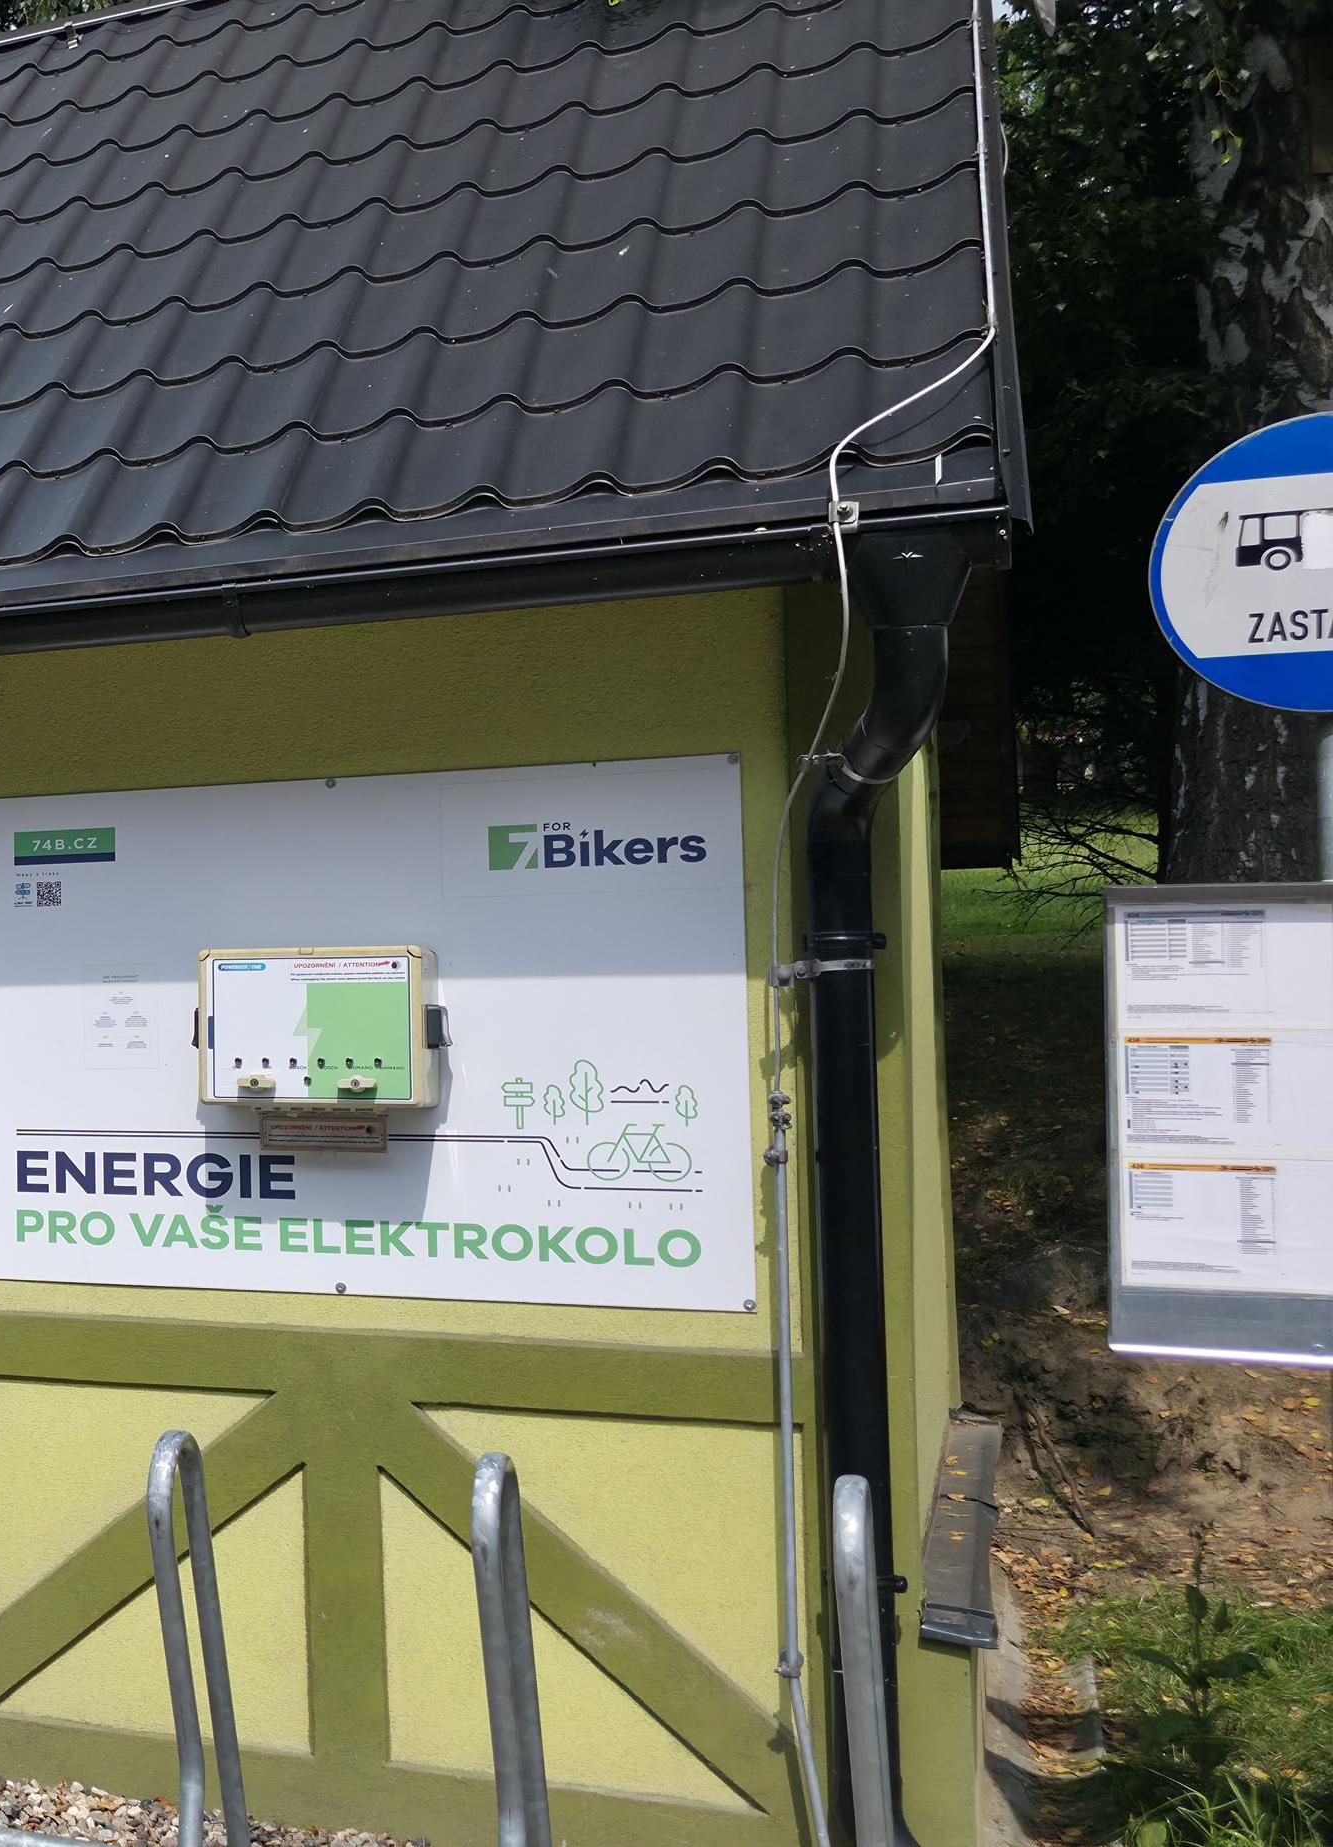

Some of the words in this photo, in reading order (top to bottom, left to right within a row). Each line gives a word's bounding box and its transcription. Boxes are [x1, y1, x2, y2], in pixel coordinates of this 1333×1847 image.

[32, 837, 97, 852] 74B.CZ
[542, 822, 571, 832] FOR
[543, 828, 707, 868] Bikers
[16, 1150, 296, 1200] ENERGIE
[16, 1208, 114, 1250] PRO
[129, 1204, 261, 1253] VAŠE
[279, 1218, 702, 1268] ELEKTROKOLO
